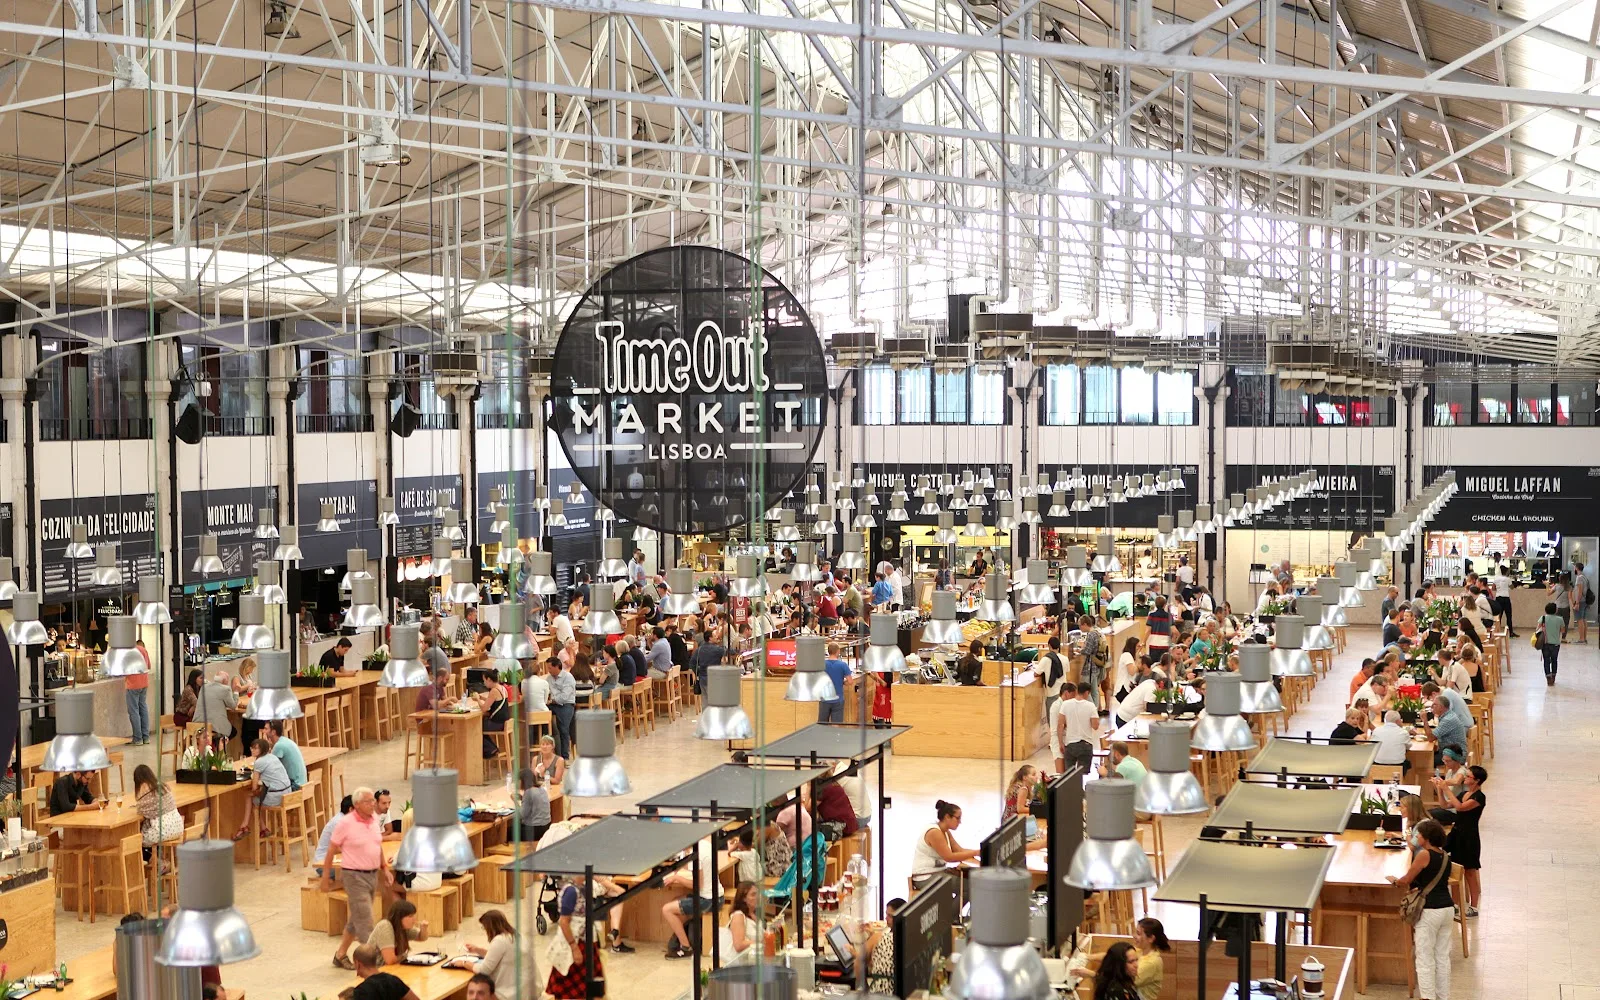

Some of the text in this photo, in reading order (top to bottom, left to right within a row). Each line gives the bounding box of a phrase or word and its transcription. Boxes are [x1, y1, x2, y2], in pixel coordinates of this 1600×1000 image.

[596, 320, 769, 393] Time Out
[574, 401, 802, 435] MARKET
[648, 443, 728, 460] LISBOA
[1318, 475, 1357, 491] VIEIRA
[1465, 476, 1561, 493] MIGUEL LAFFAN
[401, 487, 415, 509] CAFÉ
[416, 490, 424, 508] DE
[87, 514, 101, 537] DA
[103, 510, 155, 536] FELICIDADE
[207, 503, 254, 527] MONTE MAR
